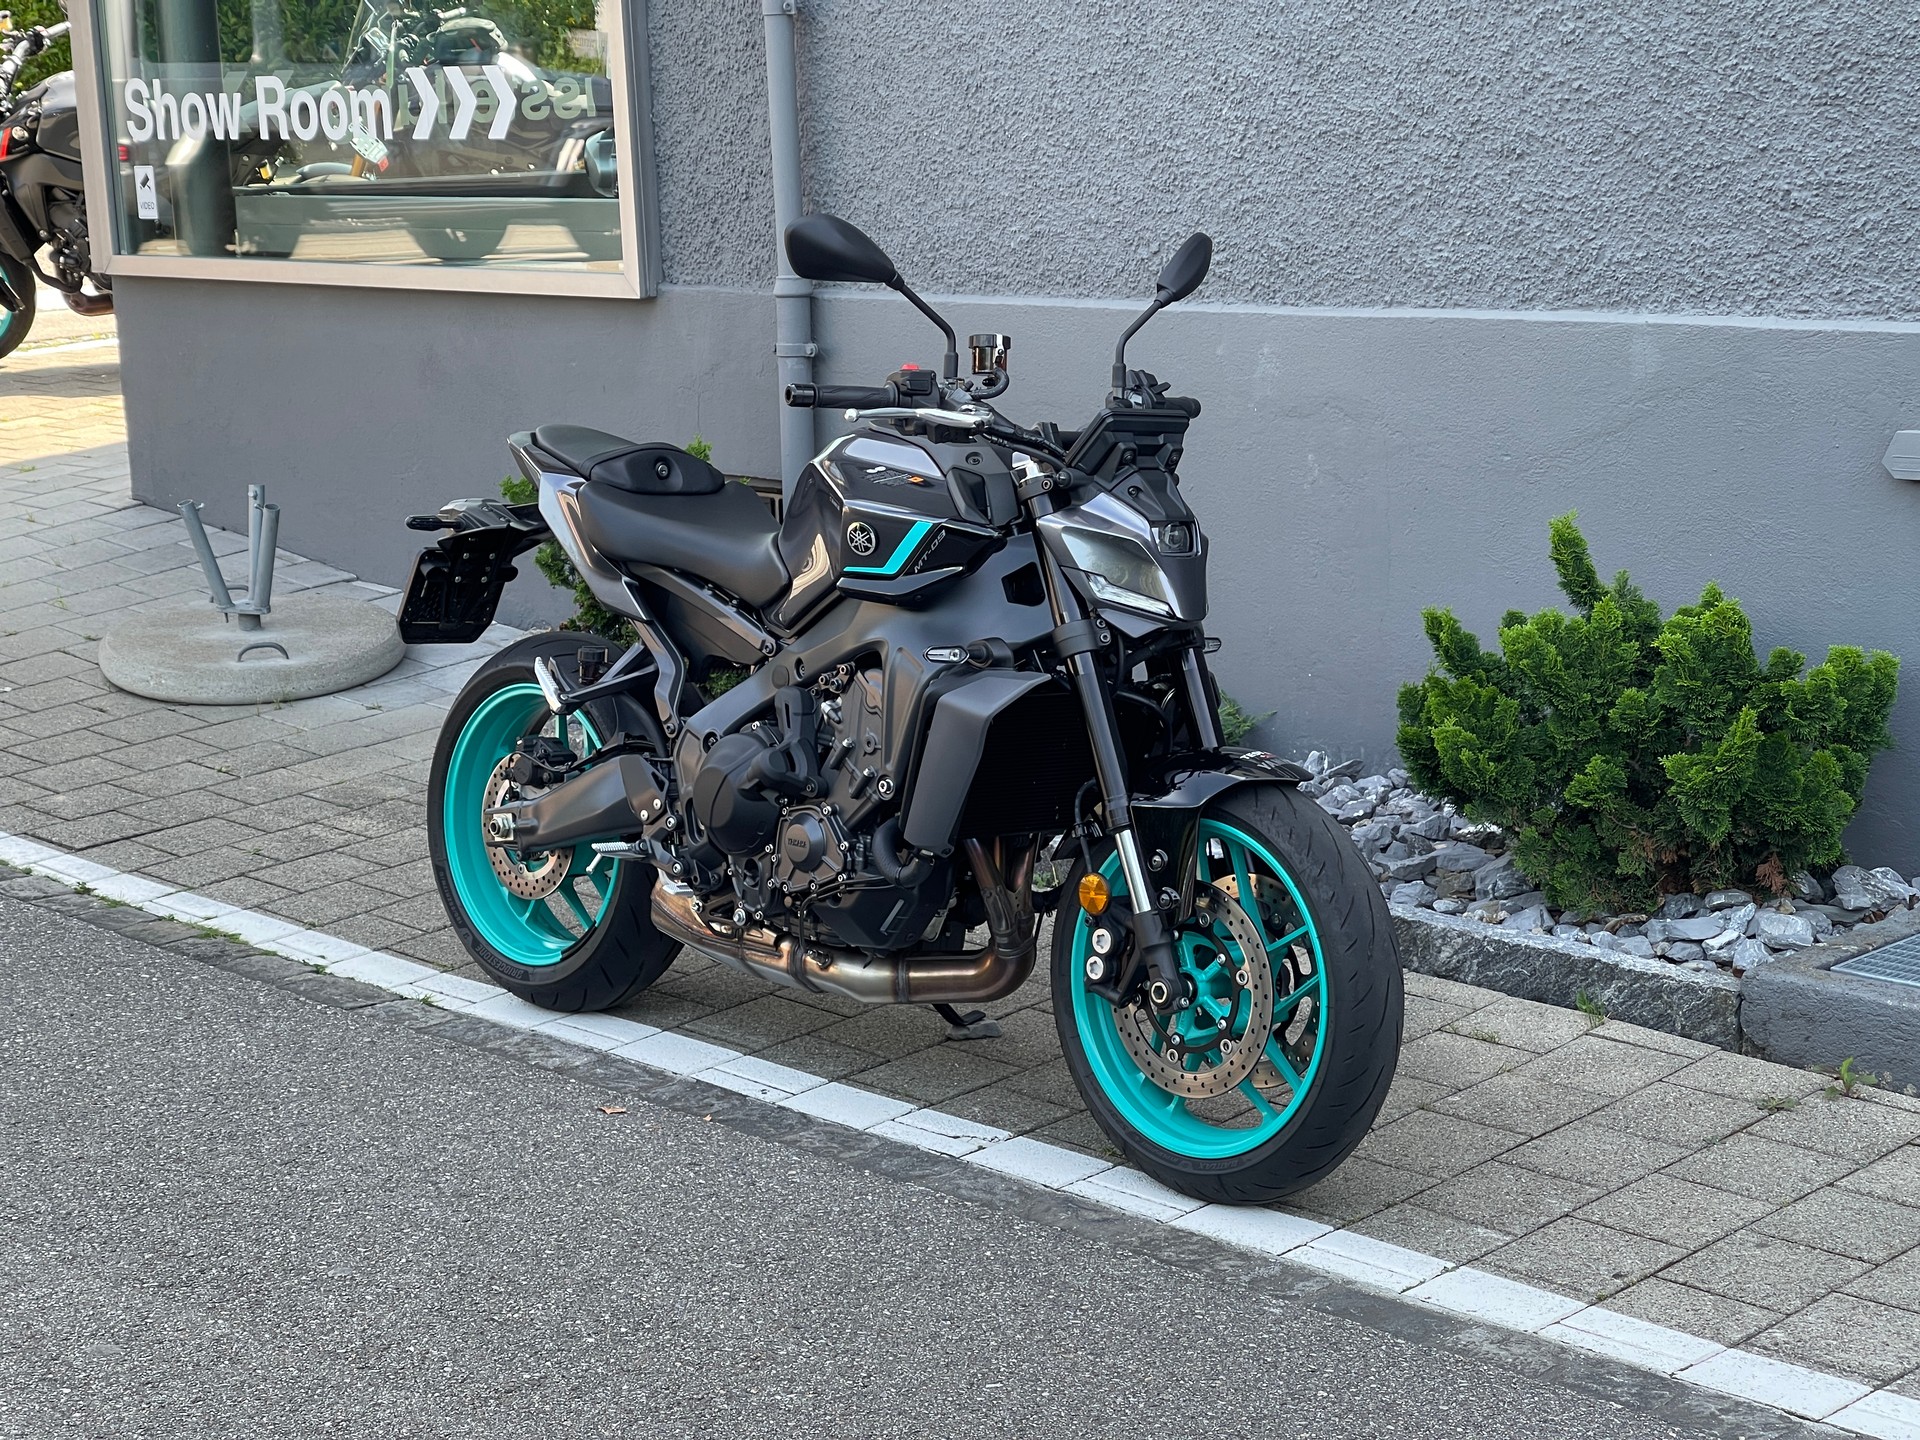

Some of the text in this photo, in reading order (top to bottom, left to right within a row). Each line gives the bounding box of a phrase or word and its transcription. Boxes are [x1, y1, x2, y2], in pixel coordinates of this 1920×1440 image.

[124, 77, 242, 142] Show
[255, 75, 393, 142] Room
[139, 201, 155, 210] VIDEO
[914, 529, 946, 574] MT-09
[474, 944, 524, 979] BRIDGESTONE
